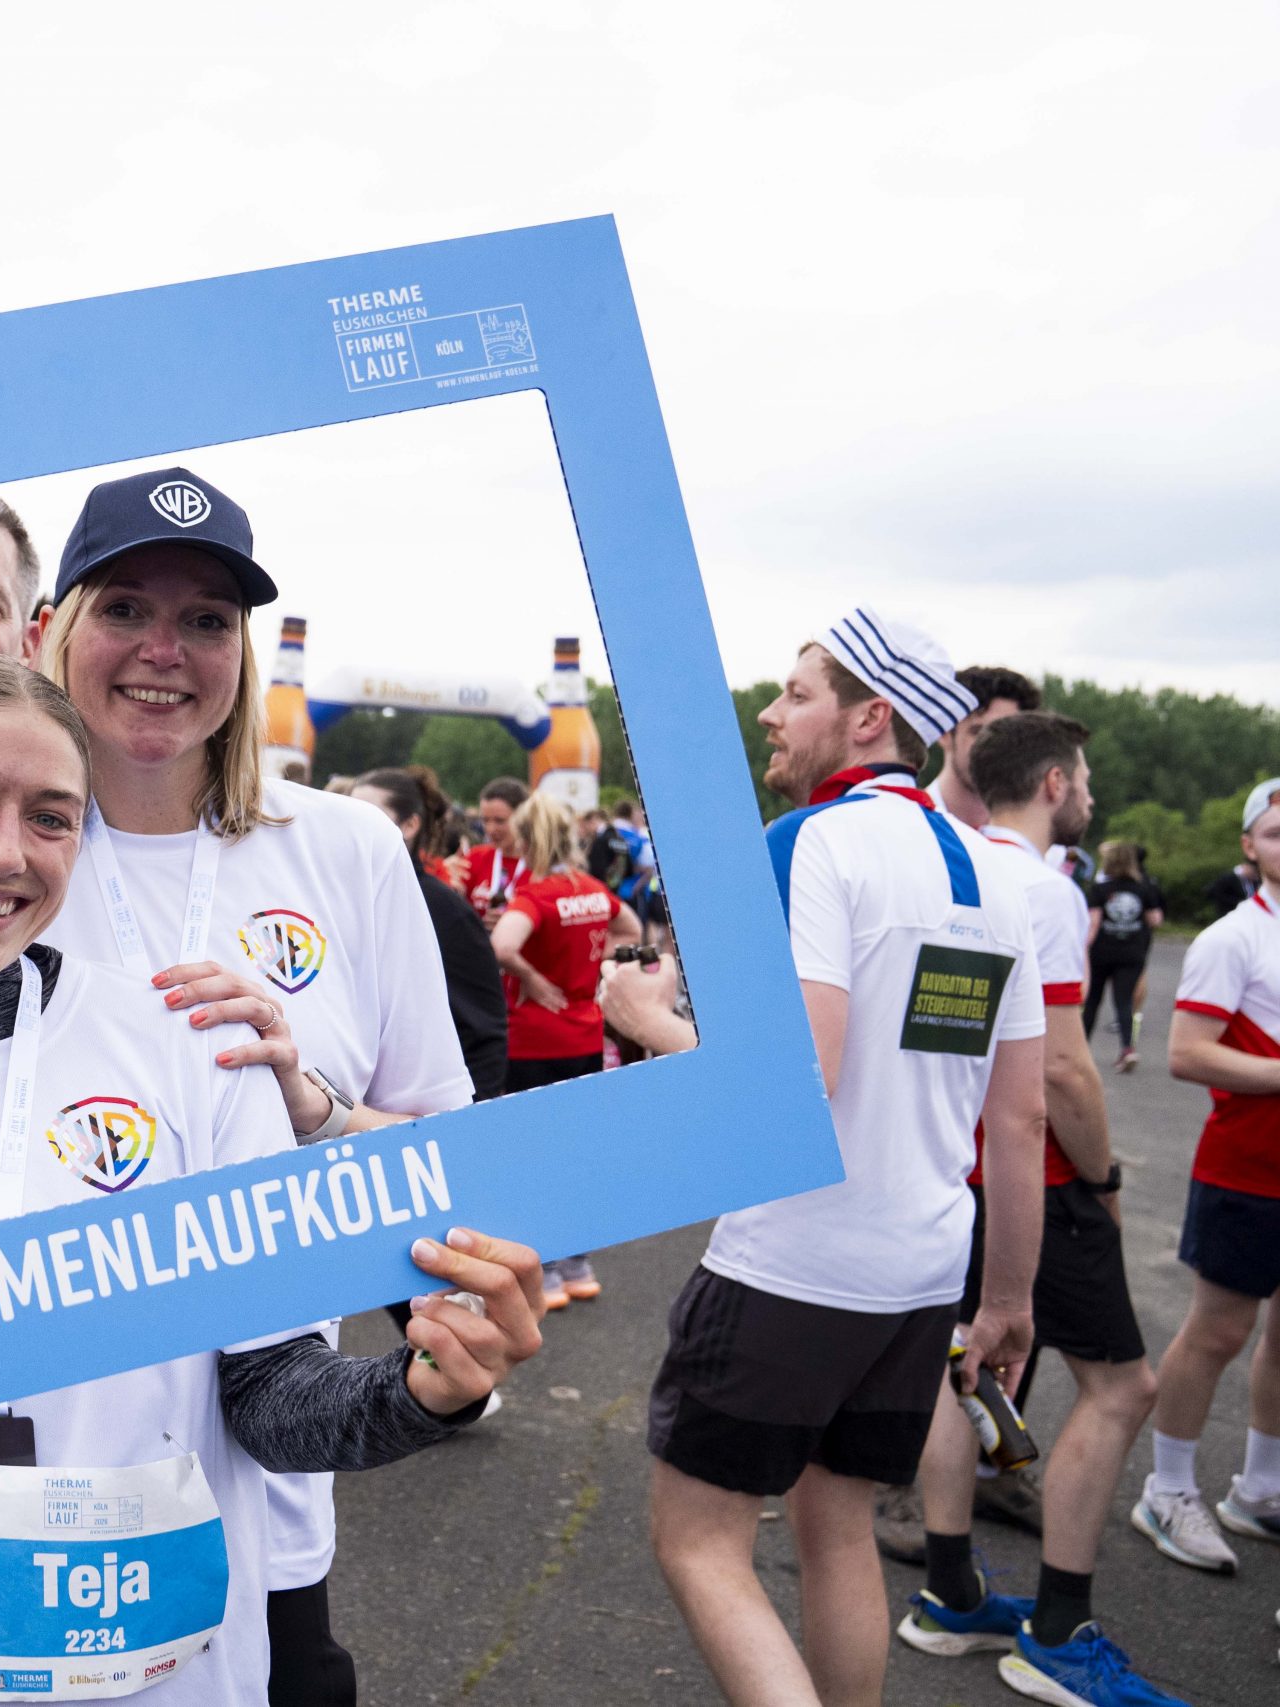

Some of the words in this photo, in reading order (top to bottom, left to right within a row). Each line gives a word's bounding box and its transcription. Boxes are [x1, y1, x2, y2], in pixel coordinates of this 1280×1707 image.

[328, 285, 423, 316] THERME
[333, 306, 428, 333] EUSKIRCHEN
[346, 331, 406, 356] FIRMEN
[435, 339, 464, 356] KÖLN
[350, 351, 409, 384] LAUF
[919, 972, 973, 996] NAVIGATOR
[972, 978, 990, 998] DER
[914, 993, 989, 1019] STEUERVORTEILE
[45, 1478, 93, 1488] THERME
[48, 1501, 79, 1510] FIRMEN
[94, 1503, 108, 1511] KÖLN
[48, 1512, 79, 1525] LAUF
[33, 1552, 150, 1619] Teja
[65, 1627, 126, 1653] 2234
[12, 1674, 48, 1682] THERME
[145, 1661, 170, 1677] DKMS
